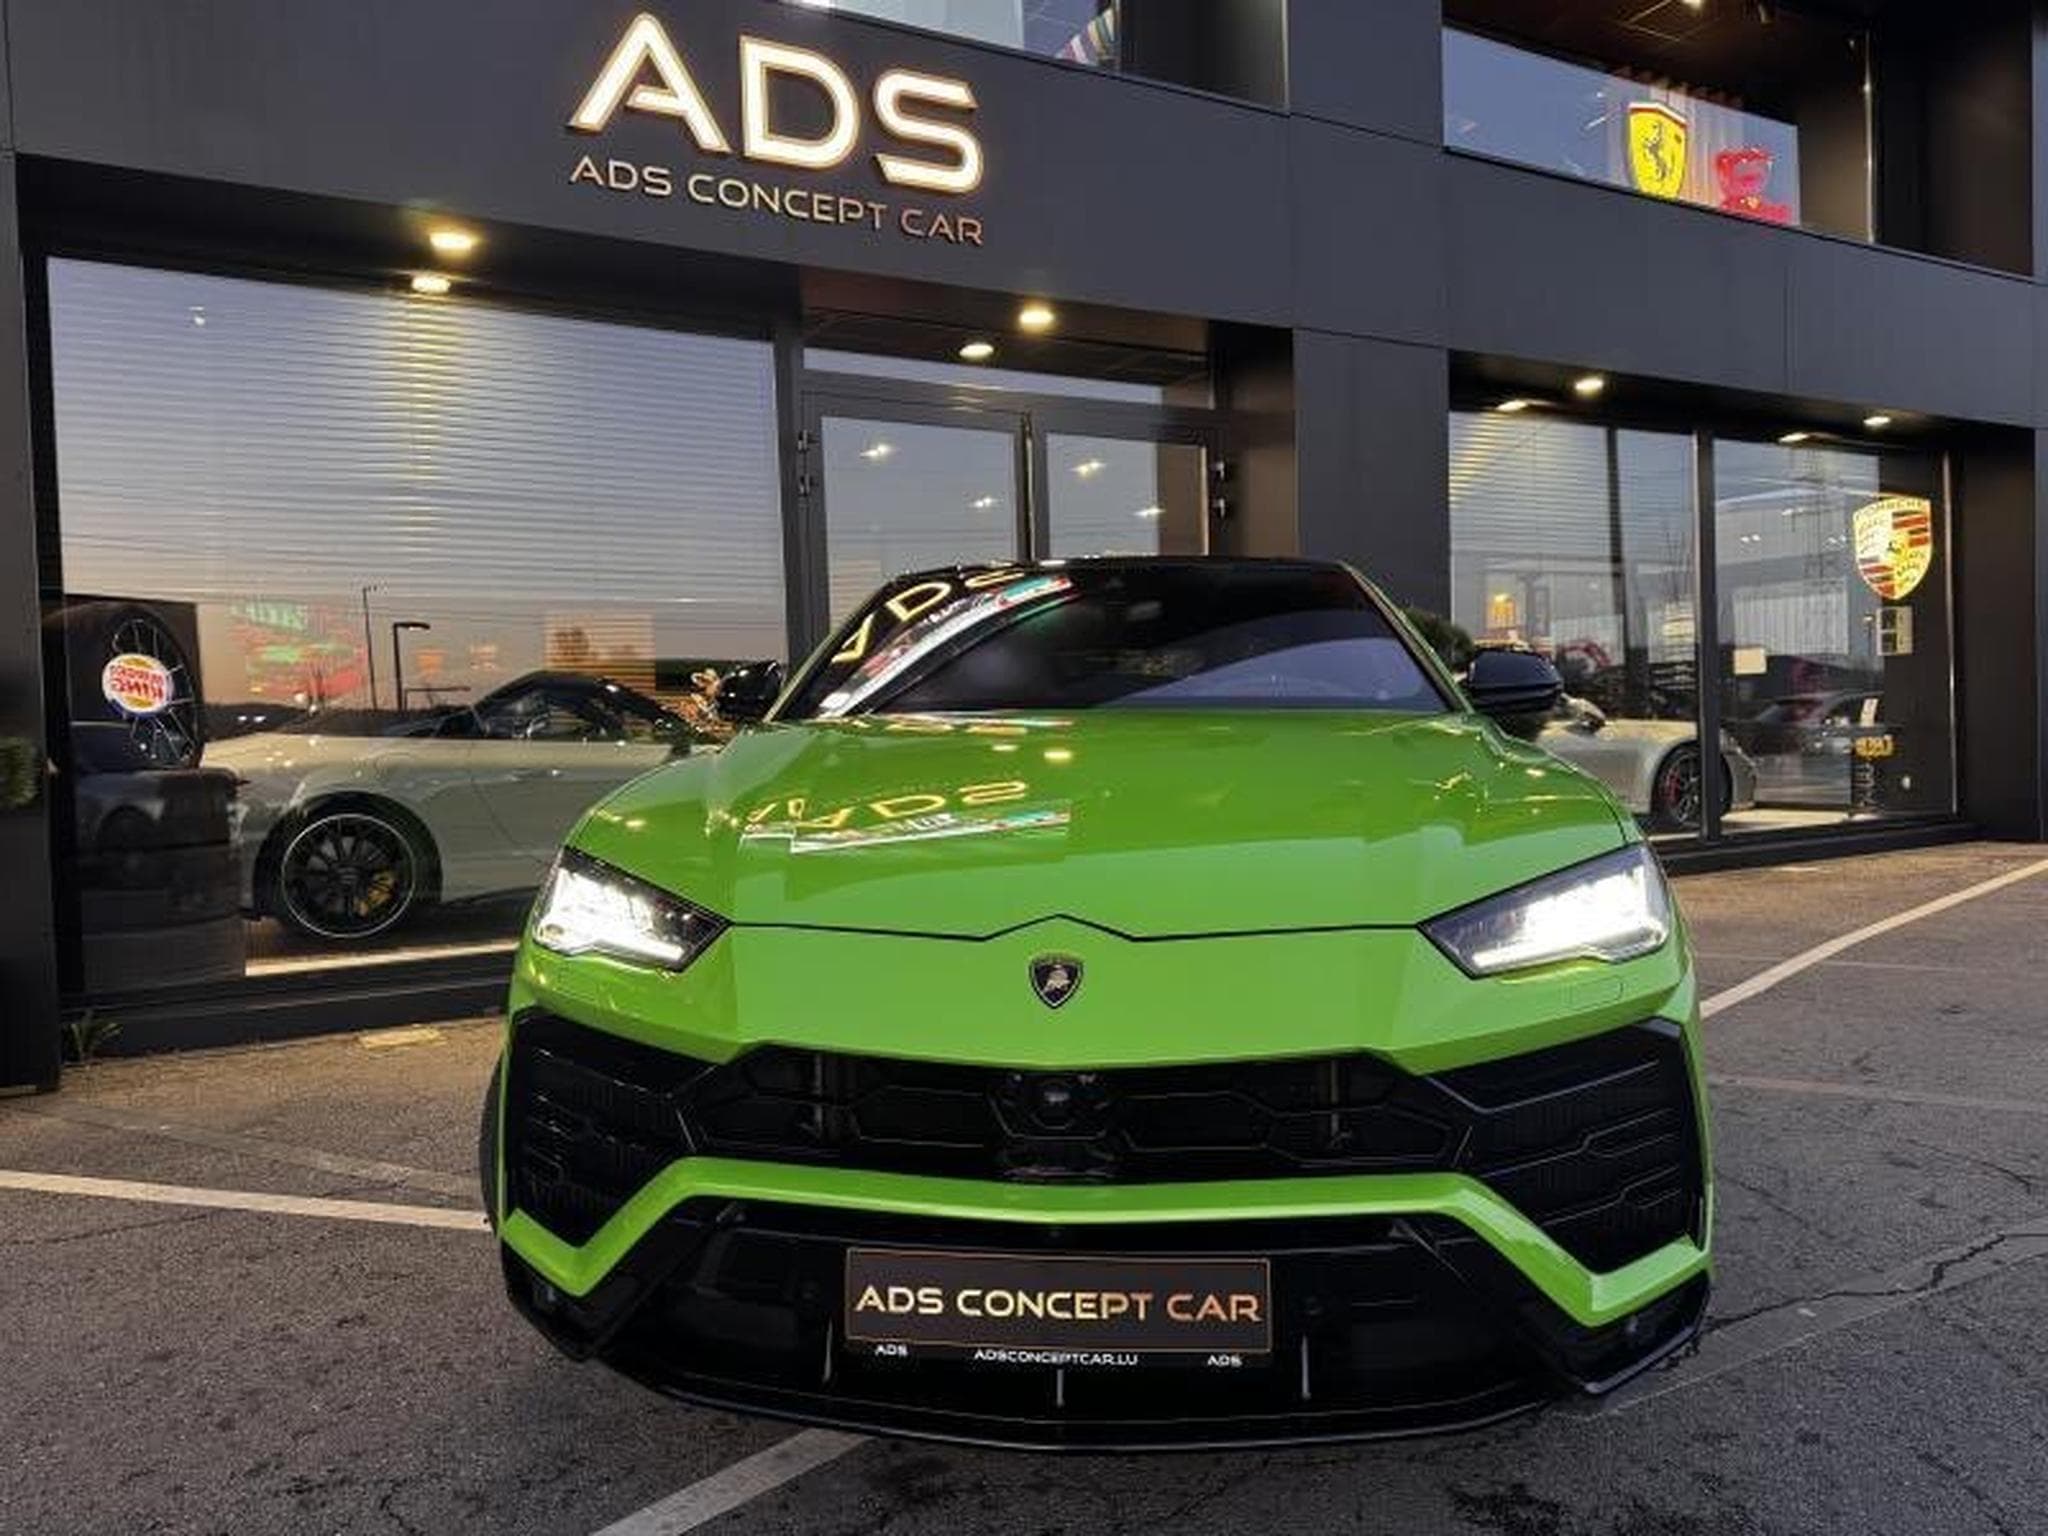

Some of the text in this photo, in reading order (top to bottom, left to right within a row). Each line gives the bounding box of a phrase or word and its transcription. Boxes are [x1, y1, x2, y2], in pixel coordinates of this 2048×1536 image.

[567, 11, 985, 194] ADS
[570, 155, 984, 246] ADS CONCEPT CAR
[855, 1285, 1262, 1323] ADS CONCEPT CAR
[875, 1344, 1242, 1367] ADS ADSCONCEPTCAR.LU ADS
